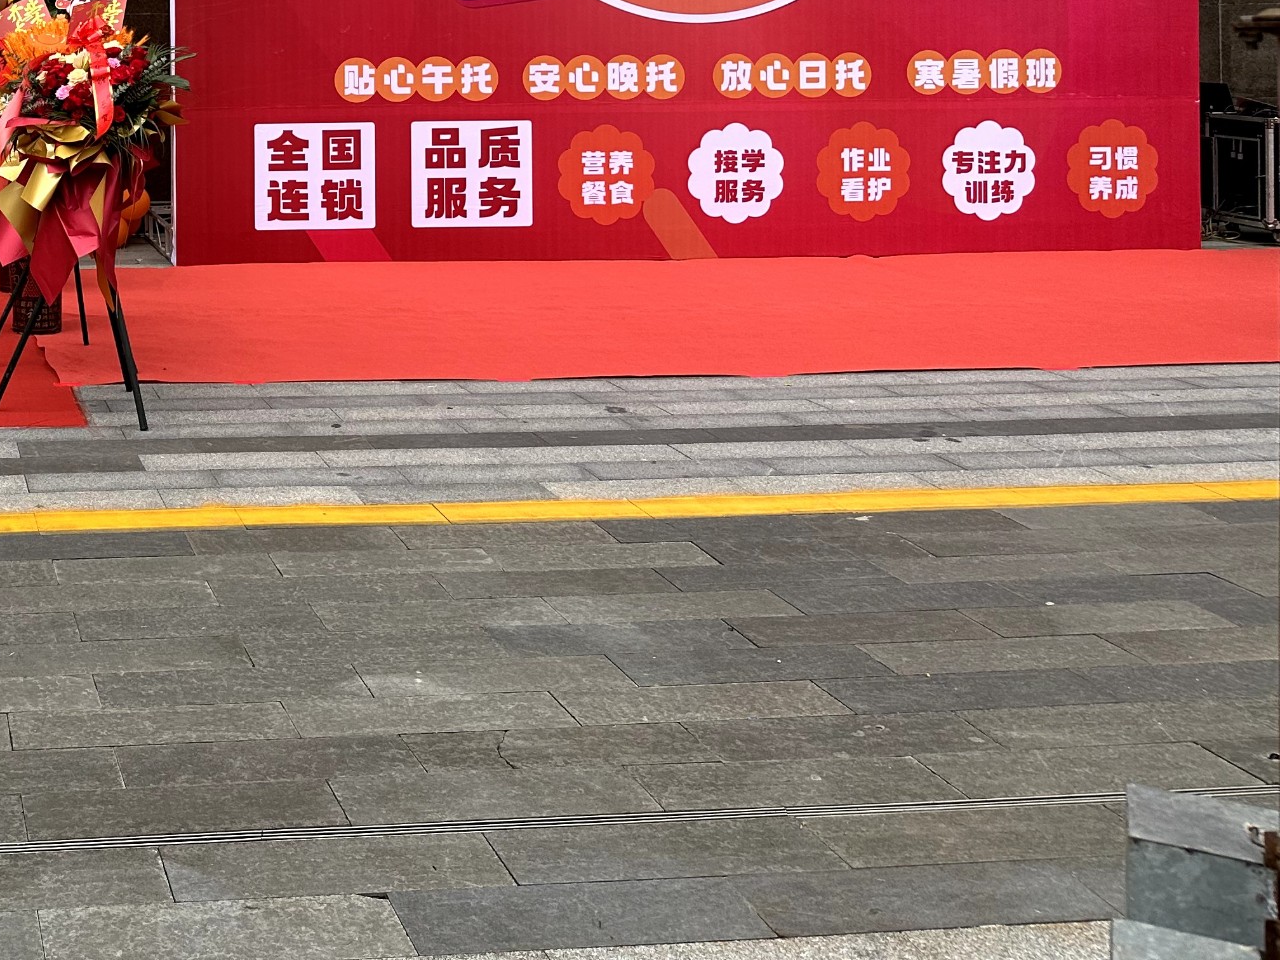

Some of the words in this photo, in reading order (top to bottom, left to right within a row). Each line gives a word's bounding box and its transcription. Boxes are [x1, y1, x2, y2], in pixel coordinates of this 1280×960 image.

[344, 64, 493, 96] 贴心午托
[529, 62, 678, 93] 安心晚托
[720, 59, 866, 91] 放心日托
[914, 57, 1057, 90] 寒暑假班
[267, 129, 362, 172] 全国
[424, 126, 521, 169] 品质
[840, 147, 891, 172] 作业
[1089, 146, 1138, 171] 习惯
[581, 150, 634, 175] 营养
[714, 149, 766, 174] 接学
[951, 149, 1027, 175] 专注力
[267, 179, 363, 222] 连锁
[424, 176, 521, 219] 服务
[581, 180, 634, 205] 餐食
[714, 179, 766, 204] 服务
[841, 177, 891, 202] 看护
[964, 179, 1015, 204] 训练
[1089, 176, 1138, 200] 养成
